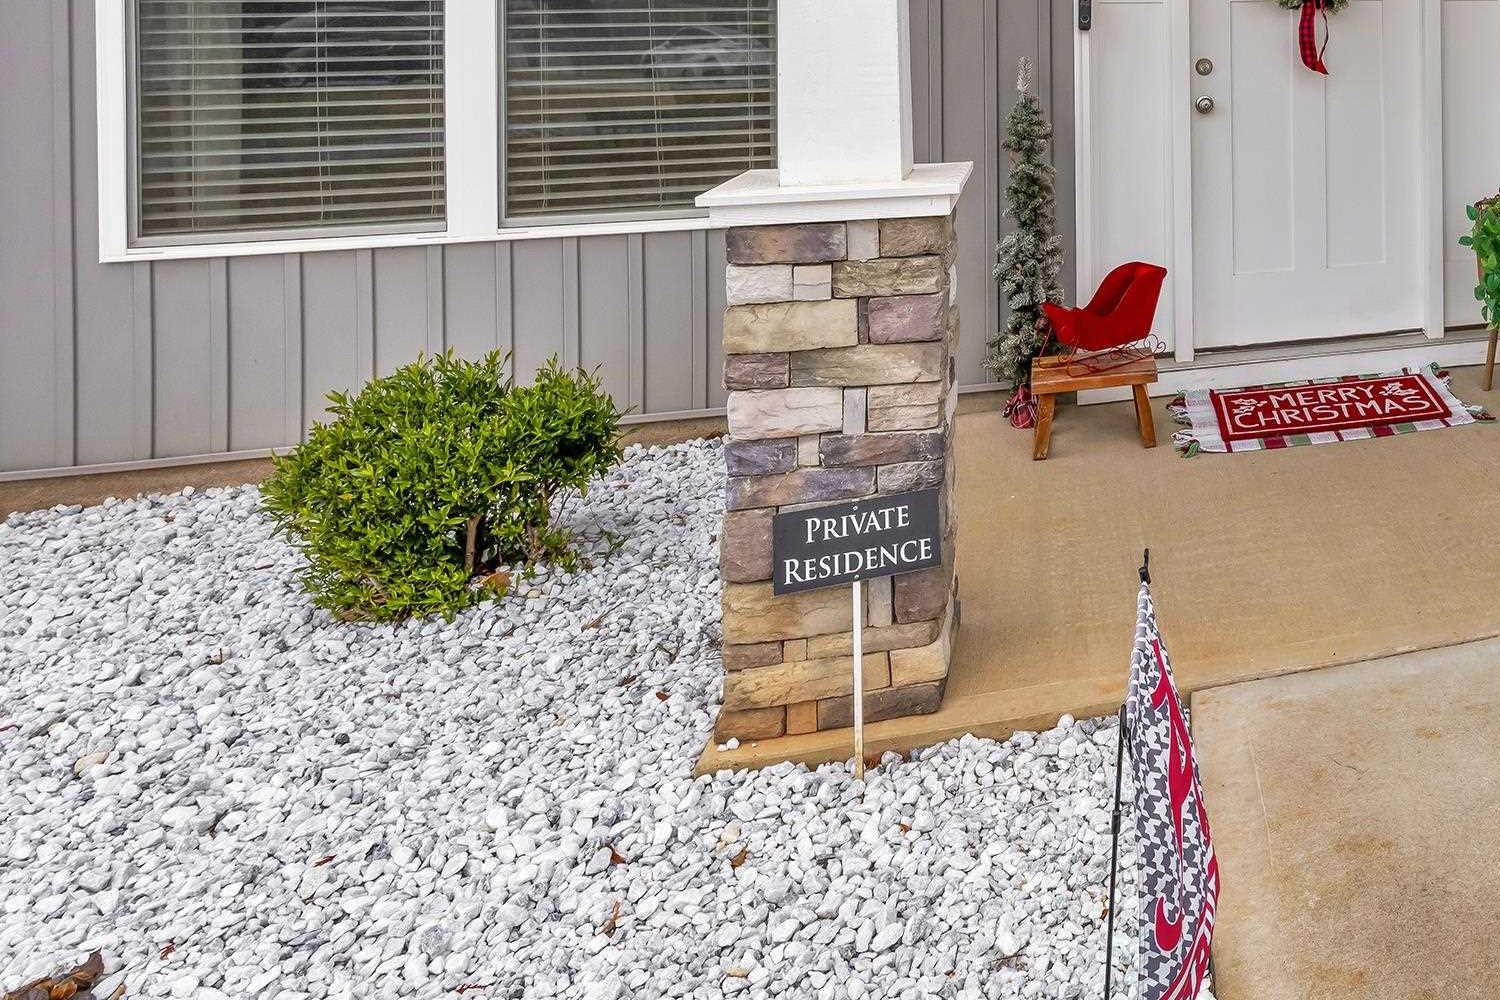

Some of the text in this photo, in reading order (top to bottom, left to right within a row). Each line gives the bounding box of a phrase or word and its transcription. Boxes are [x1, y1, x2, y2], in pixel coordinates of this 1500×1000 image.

[1234, 395, 1430, 429] CHRISTMAS
[1269, 384, 1375, 409] MERRY
[805, 504, 910, 545] PRIVATE
[783, 537, 933, 586] RESIDENCE
